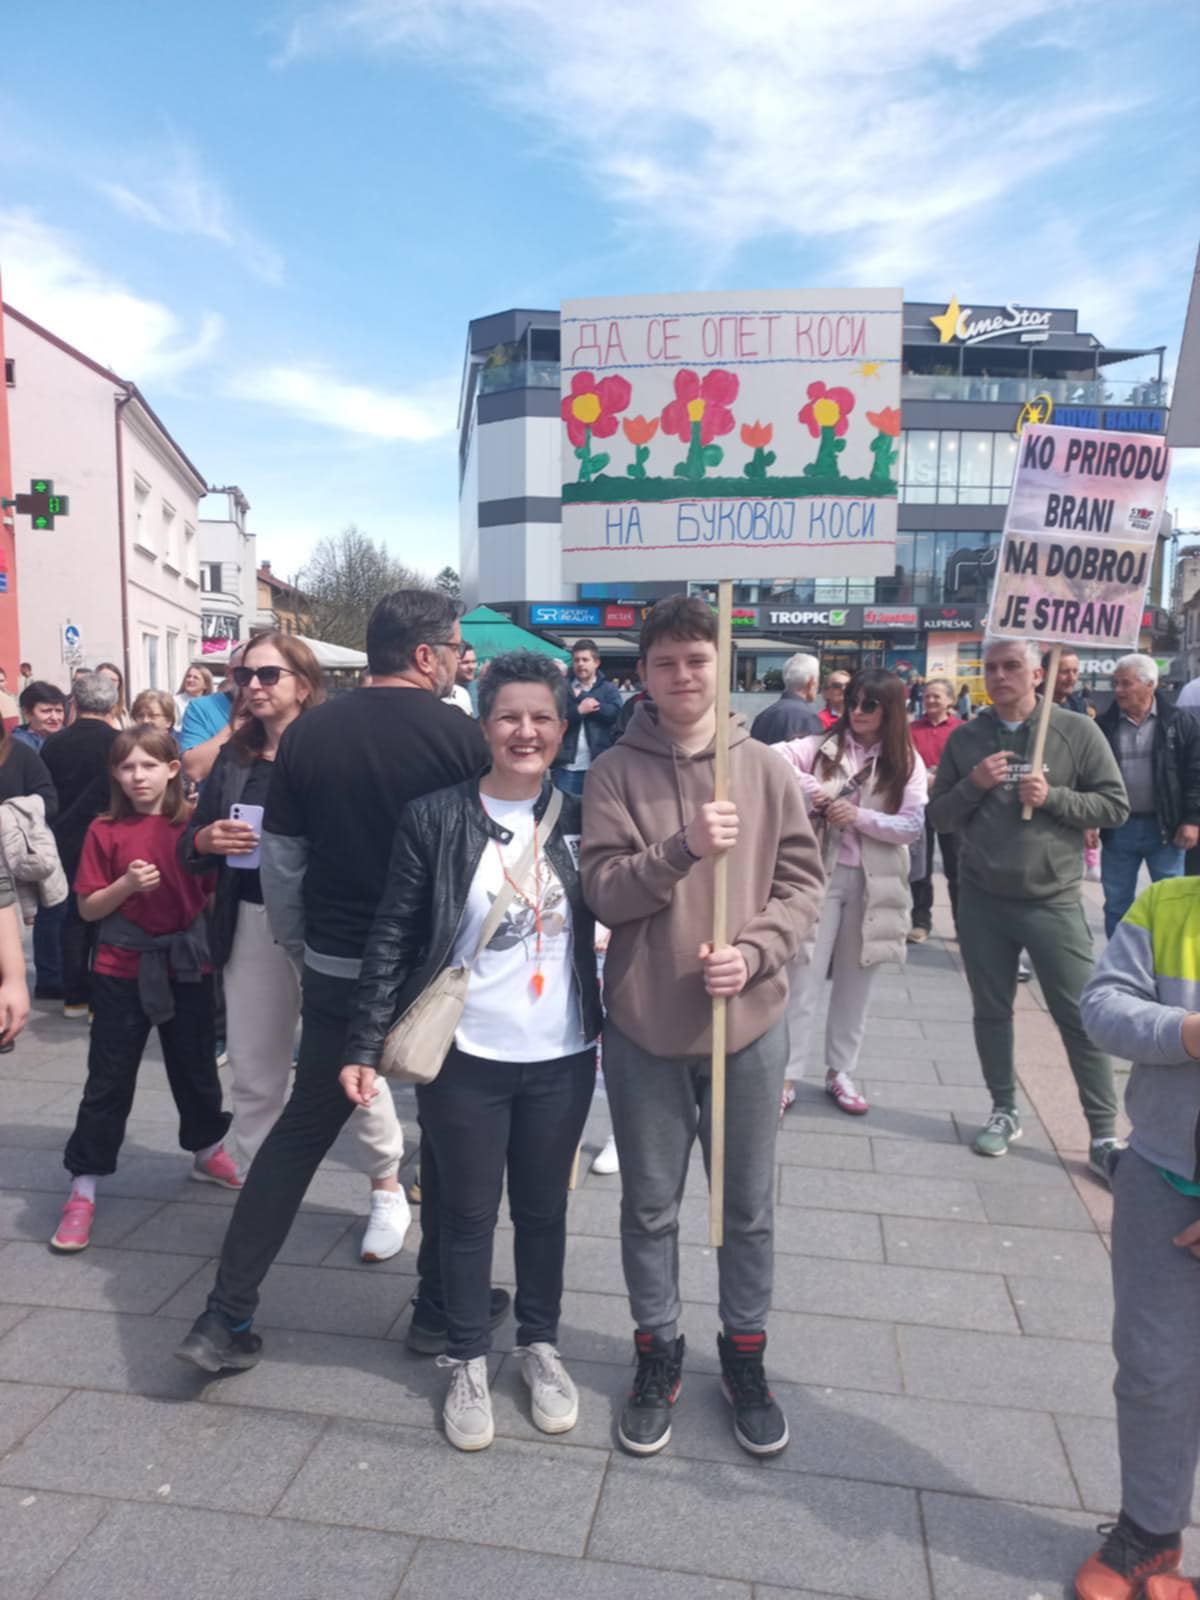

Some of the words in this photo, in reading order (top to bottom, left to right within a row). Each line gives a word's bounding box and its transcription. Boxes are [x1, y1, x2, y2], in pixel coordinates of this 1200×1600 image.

[955, 300, 1053, 340] CineStar
[571, 321, 627, 366] ДА
[647, 319, 682, 360] СЕ
[702, 316, 781, 358] ОПЕТ
[796, 316, 867, 357] КОСИ
[1104, 409, 1163, 432] BANKA
[1023, 434, 1055, 470] KO
[1064, 438, 1169, 481] PRIRODU
[606, 506, 643, 545] НА
[677, 502, 796, 541] БУКОВОЈ
[808, 502, 875, 539] КОСИ
[1044, 493, 1115, 533] BRANI
[1004, 540, 1038, 575] NA
[1046, 543, 1147, 585] DOBROJ
[769, 611, 828, 624] TROPIC
[999, 595, 1030, 628] JE
[1032, 598, 1124, 637] STRANI
[1079, 660, 1117, 673] TRO
